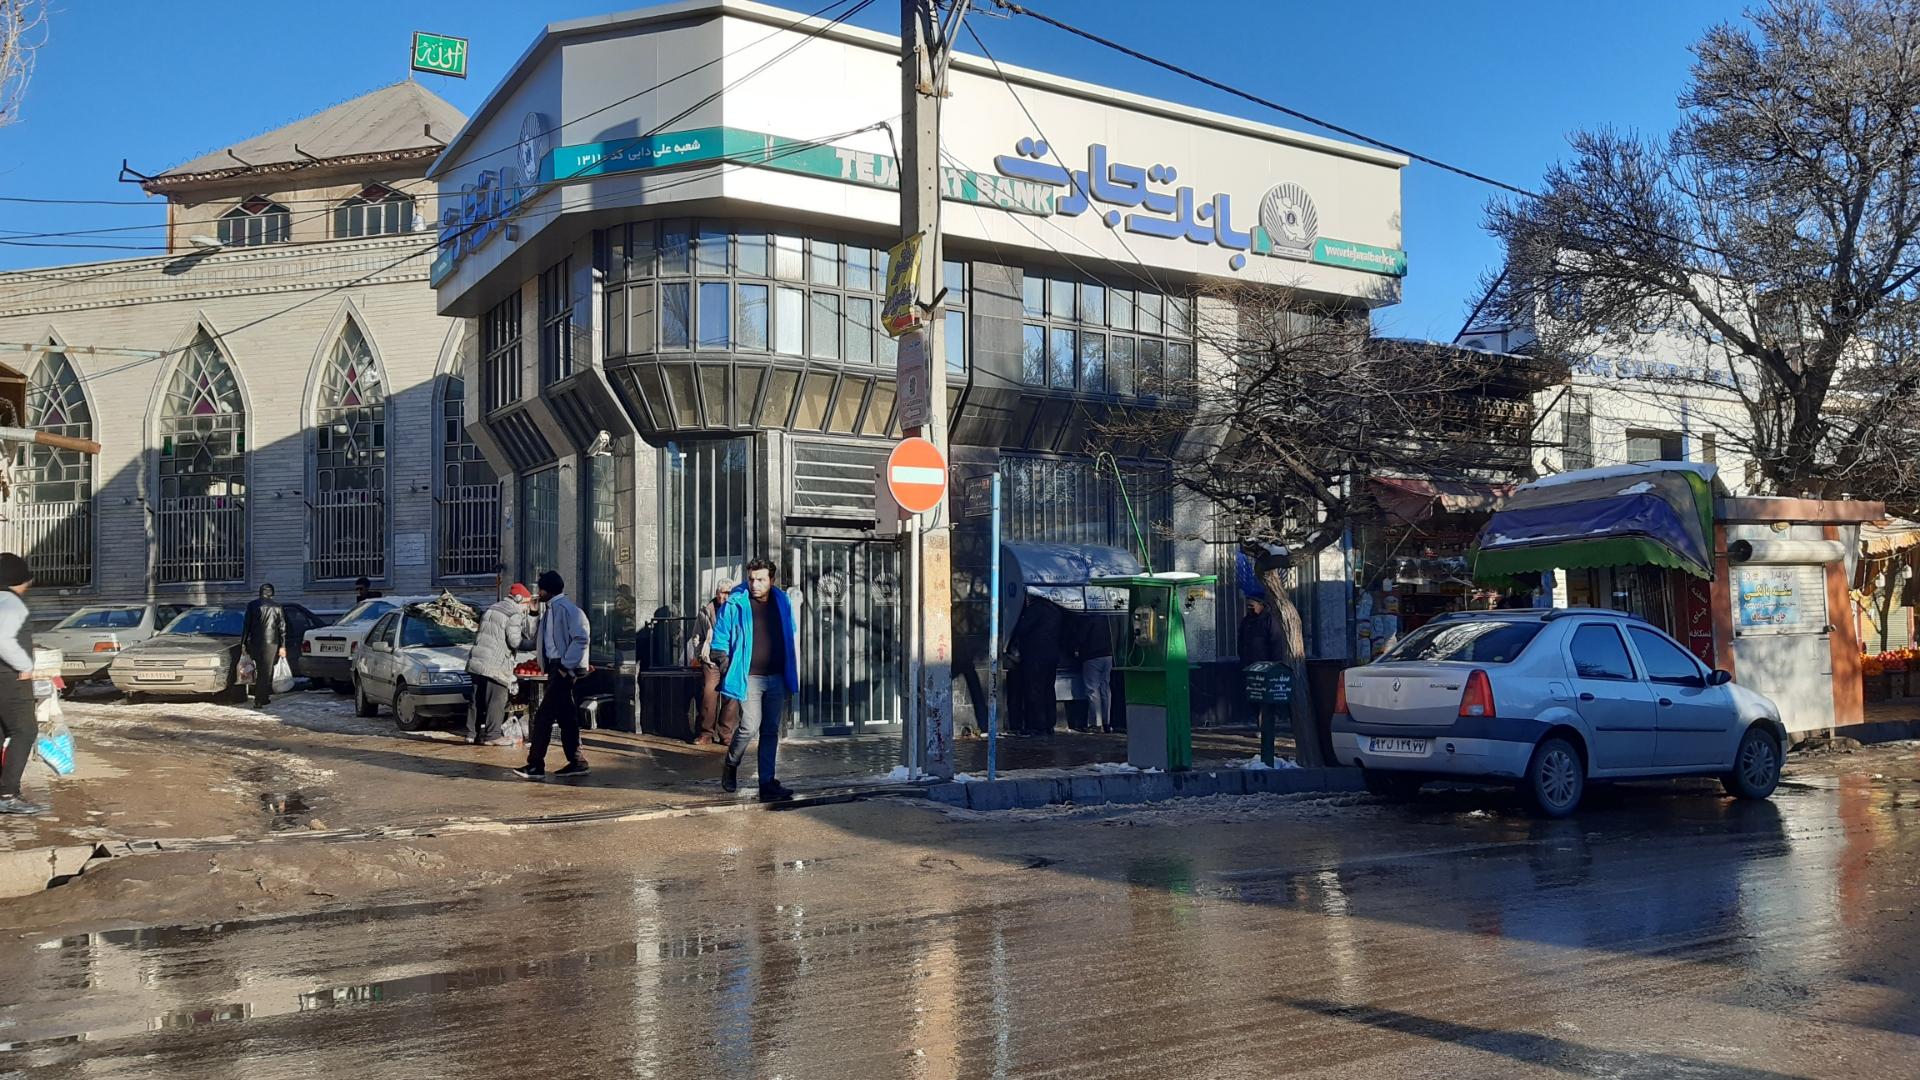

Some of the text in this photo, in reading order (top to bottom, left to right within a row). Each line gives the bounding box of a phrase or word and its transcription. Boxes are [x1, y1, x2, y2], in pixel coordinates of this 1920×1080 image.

[627, 146, 651, 161] دایی
[652, 143, 671, 158] علی
[674, 139, 701, 156] شعبه
[974, 173, 1052, 215] BANK
[994, 137, 1255, 271] بانک تجارت
